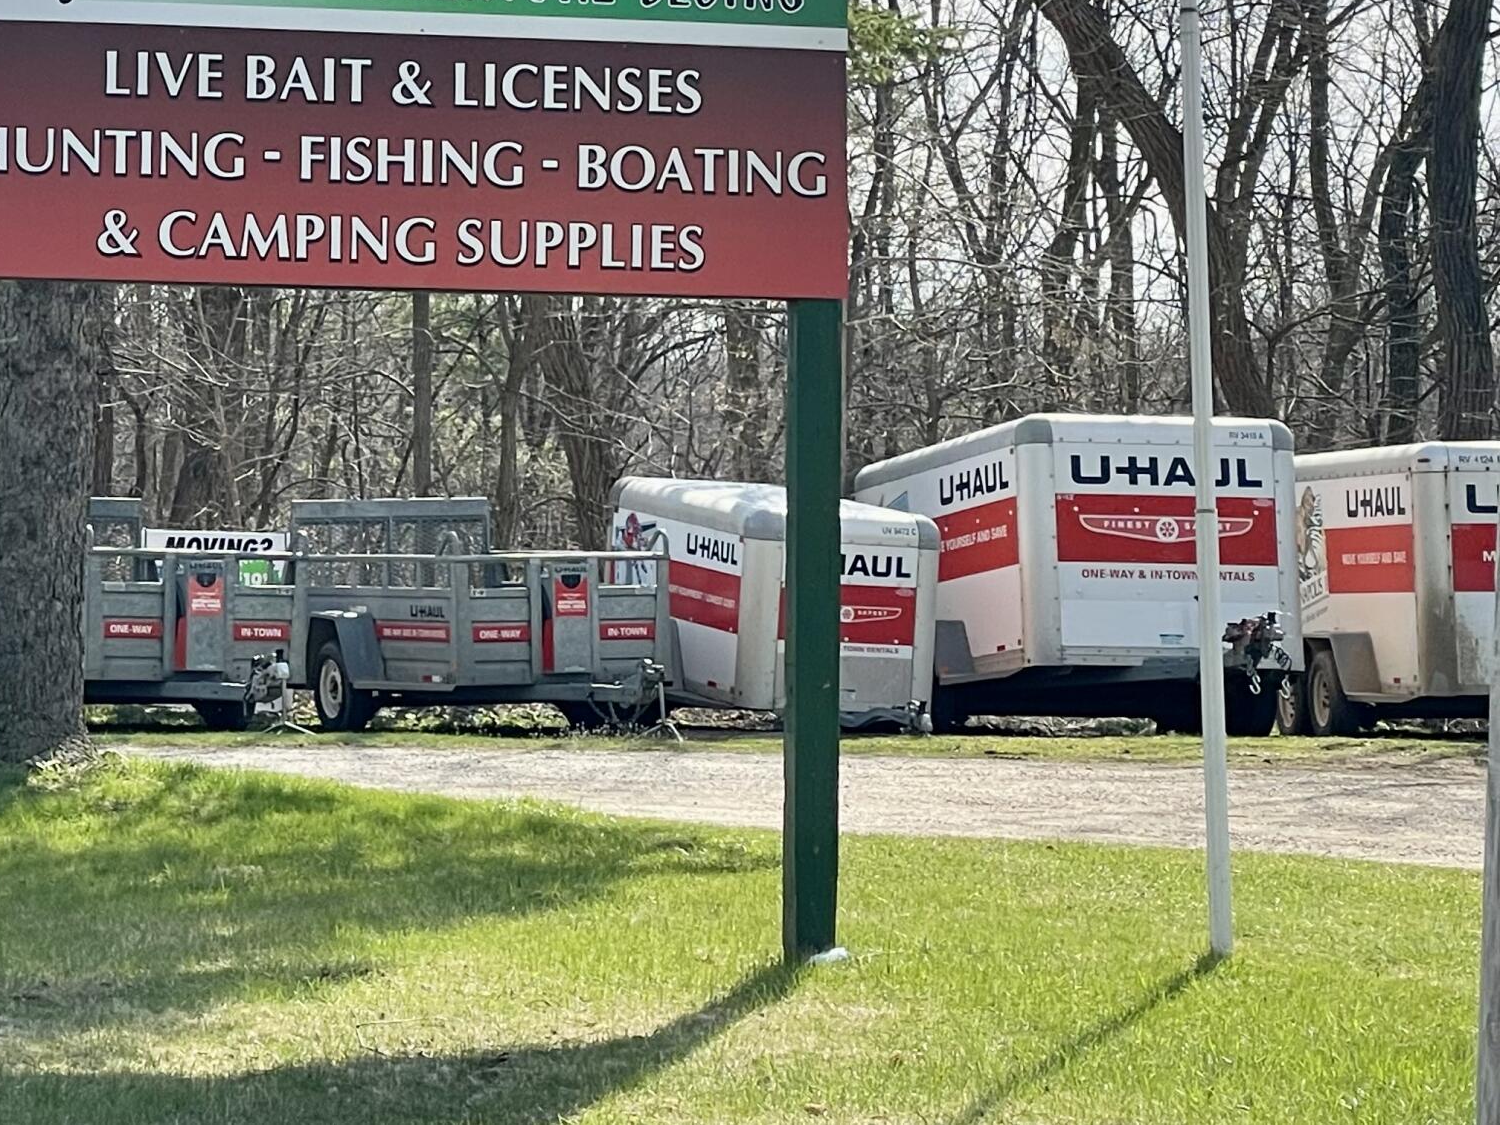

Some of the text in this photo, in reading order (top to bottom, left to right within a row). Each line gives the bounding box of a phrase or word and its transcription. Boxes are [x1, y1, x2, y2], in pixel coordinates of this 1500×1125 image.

[105, 49, 703, 115] LIVE BAIT & LICENSES
[300, 134, 524, 187] FISHING
[577, 143, 827, 196] BOATING
[96, 208, 705, 271] & CAMPING SUPPLIES
[939, 460, 1009, 506] U-HAUL
[1069, 454, 1263, 488] U-HAUL
[1346, 486, 1406, 518] U-HAUL
[686, 532, 739, 566] U-HAUL
[1219, 571, 1256, 582] NTALS
[109, 624, 153, 635] ONE-WAY
